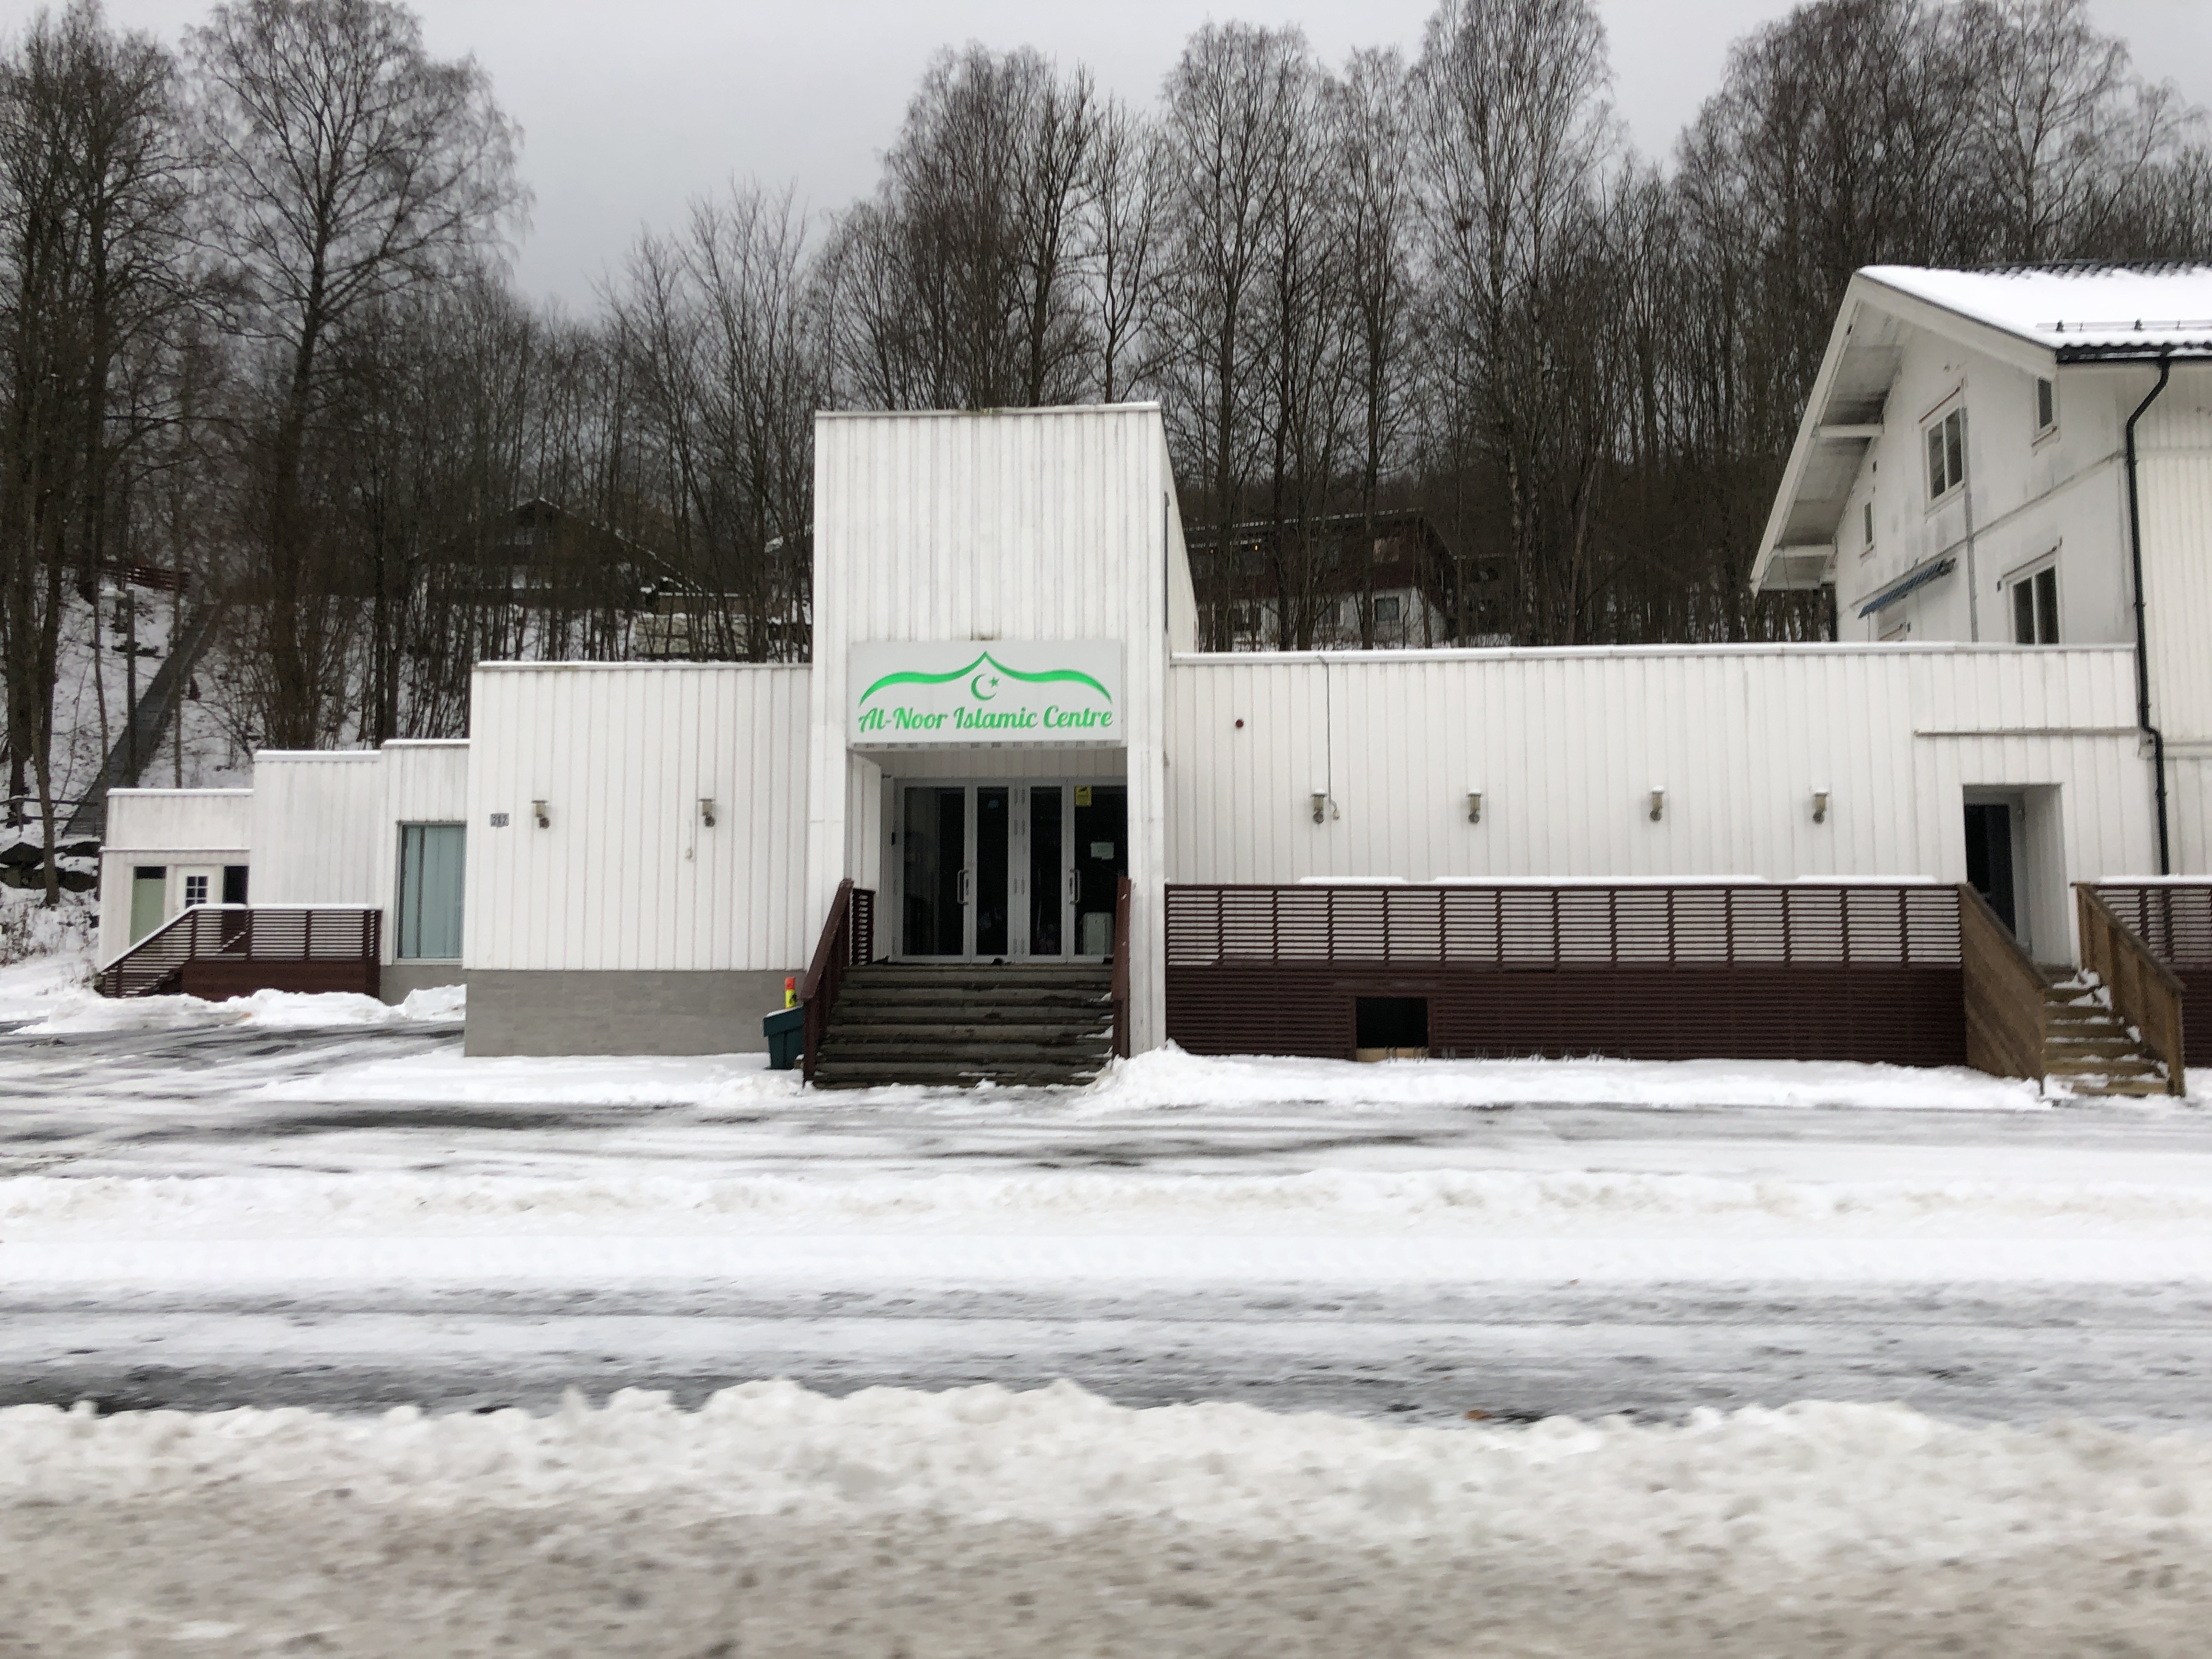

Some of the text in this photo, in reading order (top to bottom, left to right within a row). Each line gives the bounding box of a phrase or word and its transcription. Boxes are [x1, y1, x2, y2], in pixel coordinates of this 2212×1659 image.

[858, 704, 1114, 733] Al-Noor Islamic Centre
